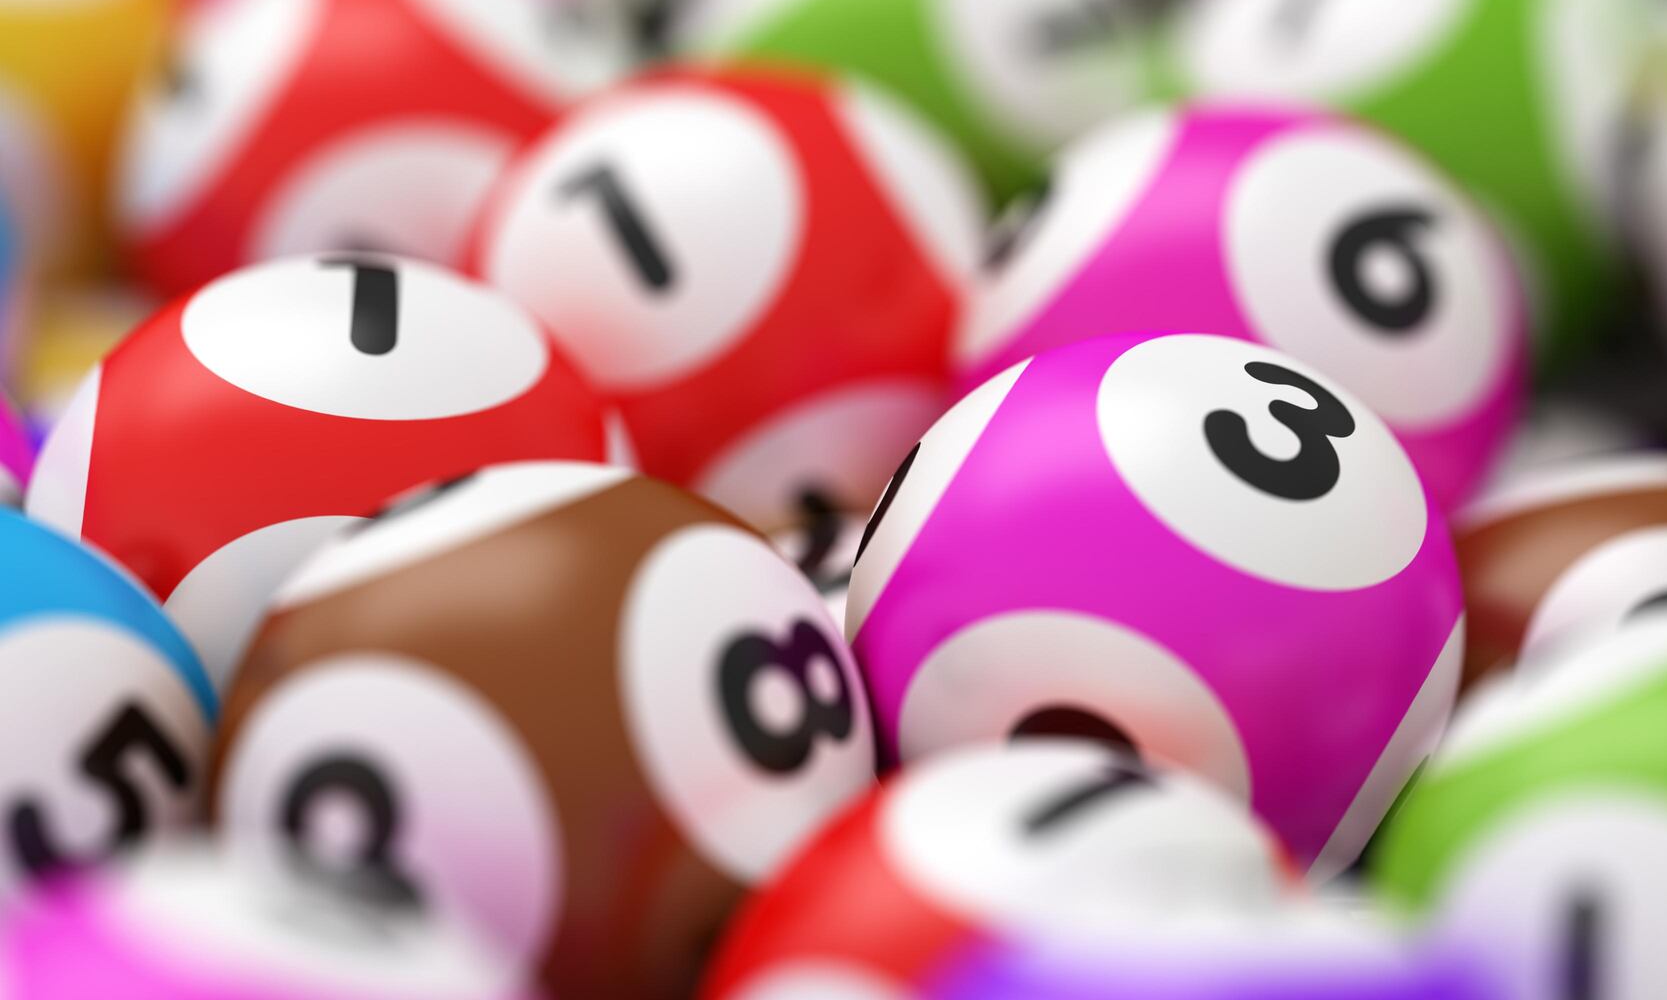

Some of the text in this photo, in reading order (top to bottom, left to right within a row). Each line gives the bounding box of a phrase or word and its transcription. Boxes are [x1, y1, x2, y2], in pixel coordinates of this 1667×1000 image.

[554, 160, 675, 300] 1
[1327, 203, 1445, 334] 6
[315, 252, 401, 356] 1
[1203, 361, 1356, 502] 3
[715, 618, 855, 775] 8
[8, 697, 192, 885] 5
